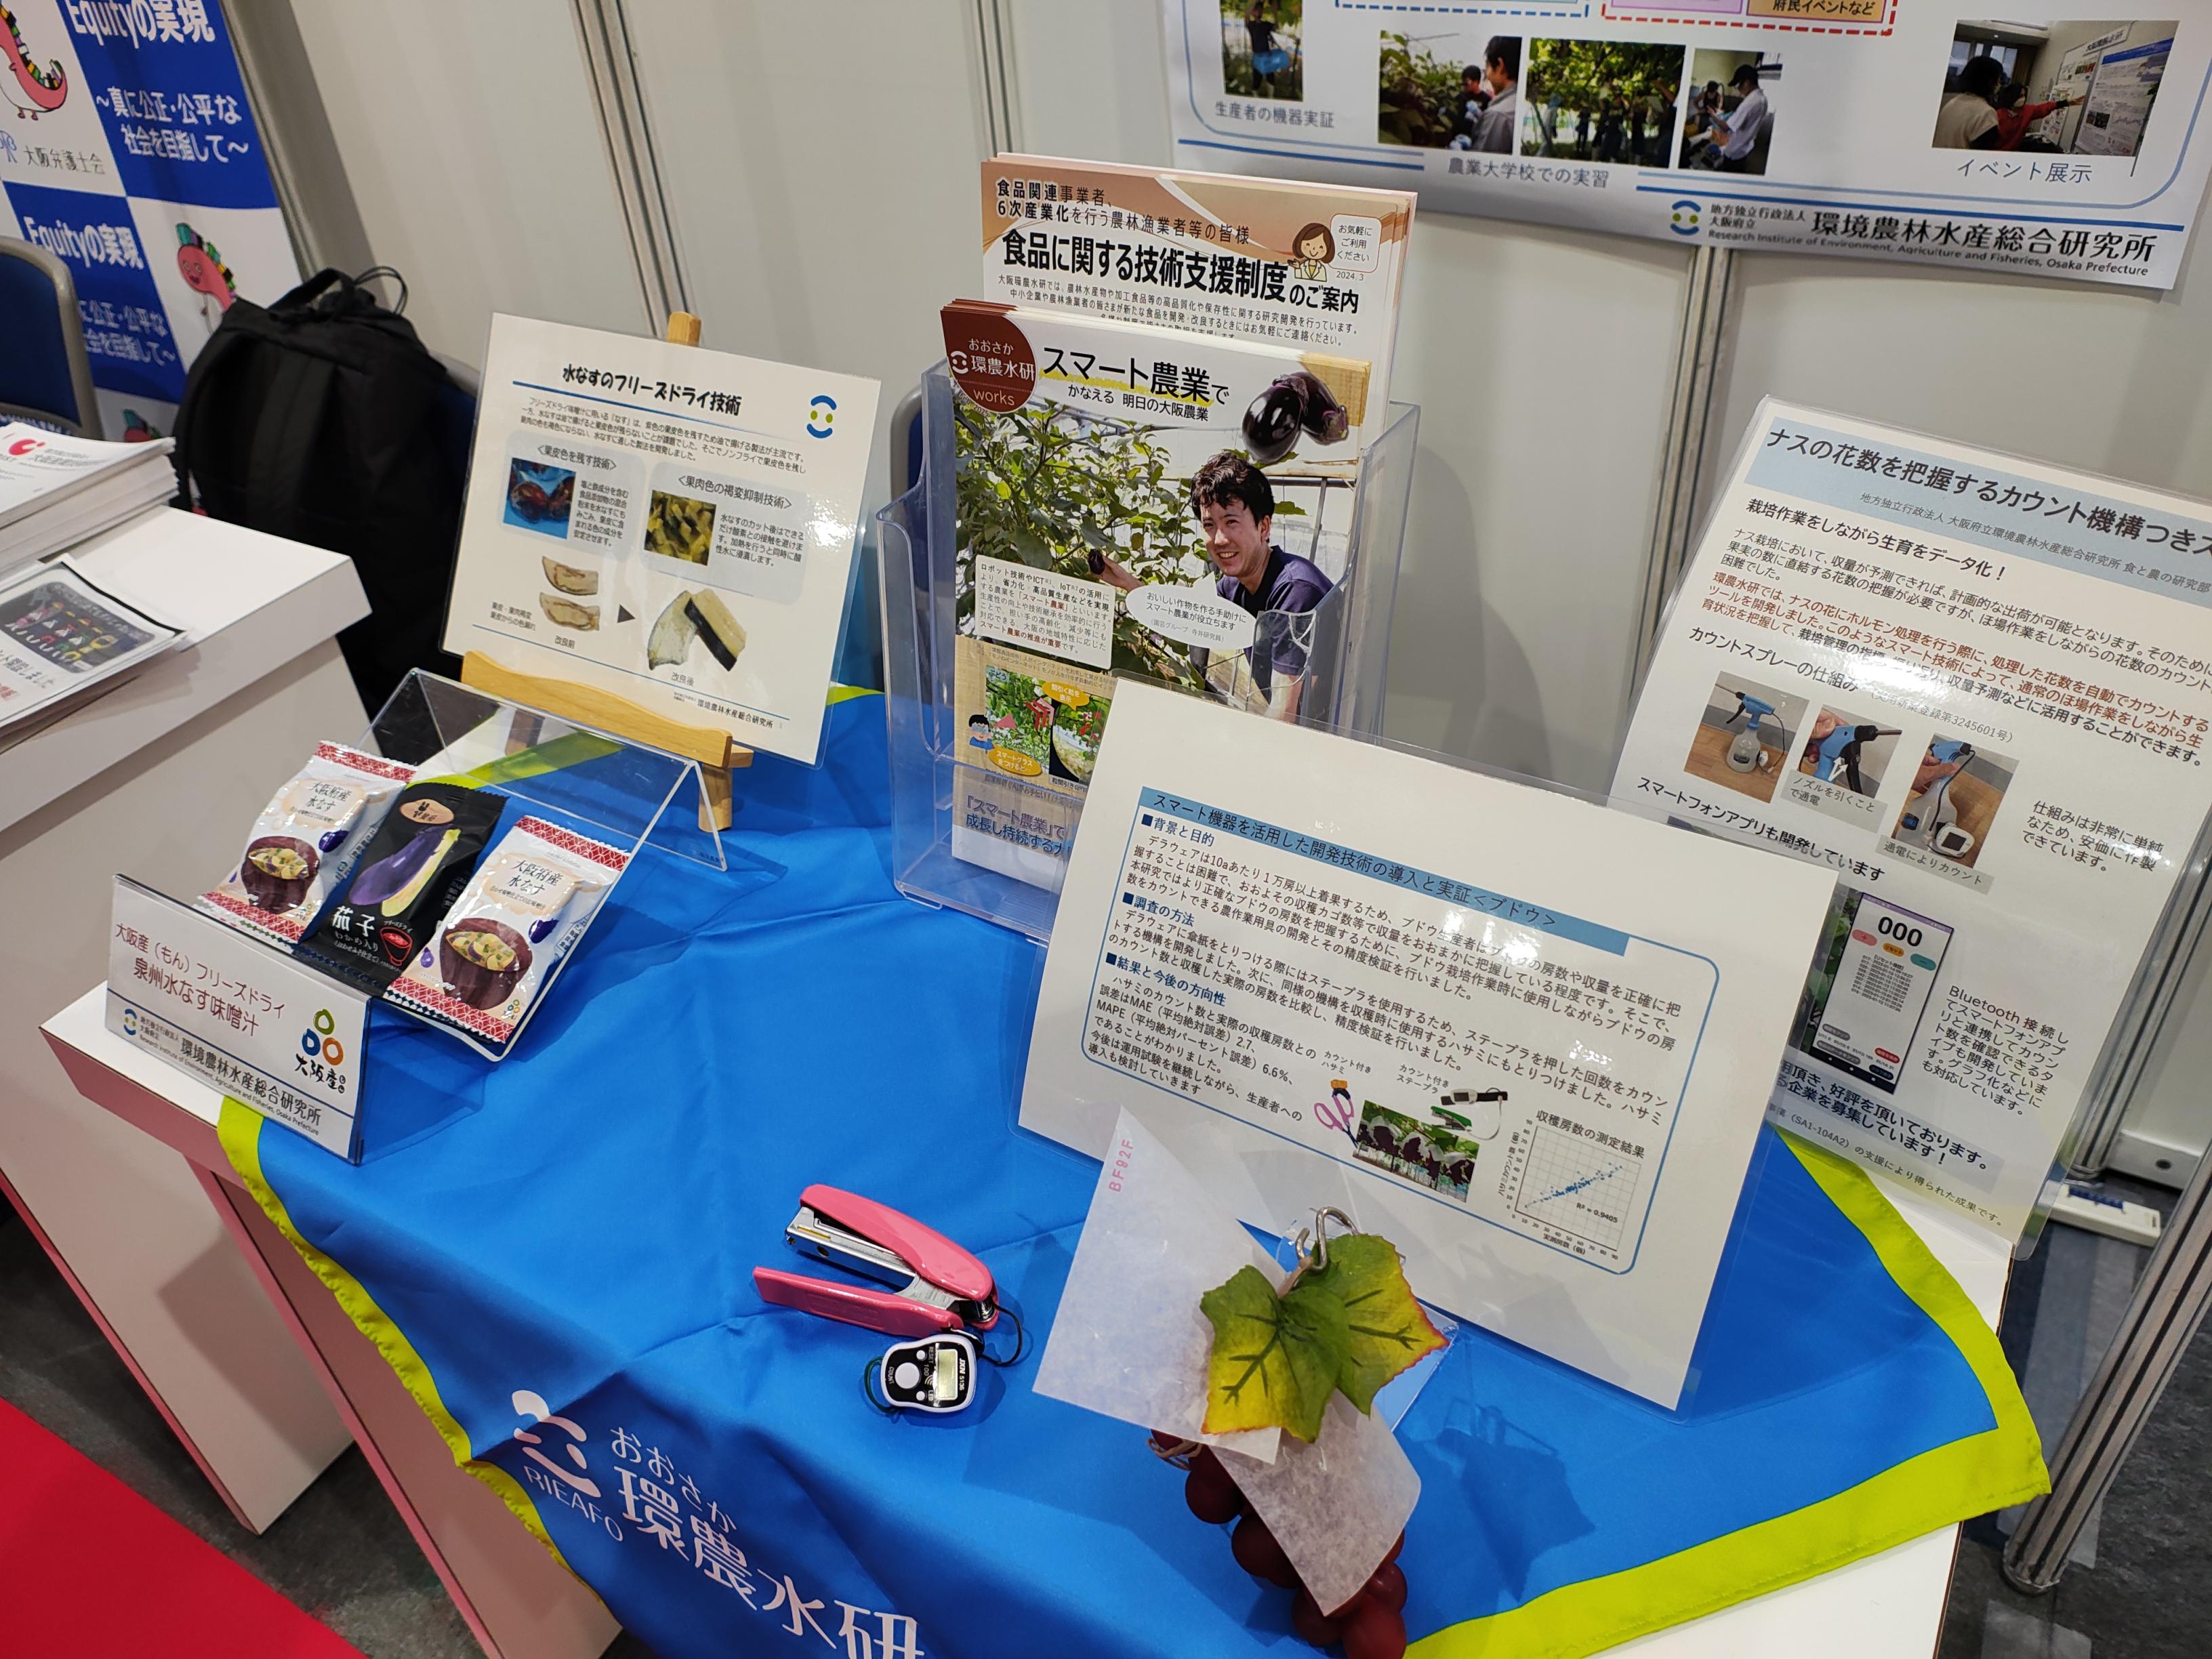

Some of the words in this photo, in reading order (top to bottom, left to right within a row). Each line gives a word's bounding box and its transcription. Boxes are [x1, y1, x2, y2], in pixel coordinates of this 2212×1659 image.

[1215, 101, 1334, 129] 生産者の機器実証
[23, 144, 105, 174] 大阪弁護士会
[1448, 157, 1610, 189] 農業大学校での実習
[1957, 161, 2093, 184] イベント展示
[1338, 224, 1373, 237] お気軽に
[1340, 238, 1368, 249] ご利用
[1708, 216, 1756, 229] 大阪府立
[1811, 210, 2157, 262] 環境農林水産総合研究所
[1001, 228, 1359, 314] 食品に関する技術支援制度のご案内
[1336, 250, 1370, 262] ください
[1708, 228, 1755, 241] Research
[1757, 233, 1803, 245] Institute
[1805, 236, 1818, 246] of
[1897, 244, 1961, 259] Agriculture
[1965, 251, 1987, 262] and
[1990, 253, 2043, 267] Fisheries,
[2047, 258, 2083, 271] Osaka
[2085, 262, 2149, 276] Prefecture
[968, 338, 1015, 356] おおさか
[970, 354, 1035, 382] 環農水研
[562, 363, 743, 417] 水なすのフリーズドライ技術
[1042, 346, 1230, 405] スマート農業で
[972, 389, 1015, 407] works
[1067, 384, 1115, 405] かなえる
[1122, 393, 1210, 423] 明日の大阪農業
[1859, 491, 1945, 524] 地方独立行政法人
[1946, 516, 2122, 571] 大阪府立環境農林水産総合研究所
[1720, 553, 1781, 581] 困難でした。
[1145, 602, 1237, 631] スマート農業が役立ちます
[1146, 592, 1248, 623] おいしい作物を作る手助けに
[671, 672, 695, 687] 改良後
[1688, 627, 1859, 692] カウントスプレーの仕組み
[697, 698, 774, 729] 環境農林水産総合研究所
[1790, 788, 1820, 806] で通電
[1637, 777, 1886, 881] スマートフォンアプリも開発しています
[2032, 800, 2164, 854] 仕組みは非常に単純
[1883, 841, 1982, 886] 通電によりカウント
[2022, 830, 2108, 872] できています。
[1878, 916, 1923, 947] 000
[134, 957, 259, 1037] 泉州水なす味噌汁
[1112, 976, 1317, 1059] ハサミのカウント数と実際の収穫房数との
[1094, 1016, 1223, 1074] であることがわかりました。
[1940, 1009, 2059, 1067] リと連携してカウン
[1946, 998, 2066, 1055] てスマートフォンアプ
[1088, 1043, 1202, 1095] 導入も検討しています
[1322, 1061, 1345, 1075] ハサミ
[1324, 1050, 1372, 1074] カウント付き
[1931, 1036, 2048, 1097] イプも開発していま
[1934, 1022, 2054, 1082] ト数を確認できるタ
[180, 1037, 322, 1126] 環境農林水産総合研究所
[1396, 1074, 1439, 1094] ステープラ
[1399, 1063, 1450, 1089] カウント付き
[1923, 1059, 2024, 1116] も対応しています。
[1928, 1047, 2041, 1109] す。グラフ化などに
[1536, 1109, 1646, 1160] 収穫房数の測定結果
[1108, 1139, 1136, 1193] BF92F
[1593, 1209, 1618, 1223] 0.9405
[958, 1357, 966, 1375] JXN
[611, 1427, 737, 1534] おおさか
[523, 1465, 623, 1542] RIEAFO
[613, 1466, 926, 1659] 環農水研
